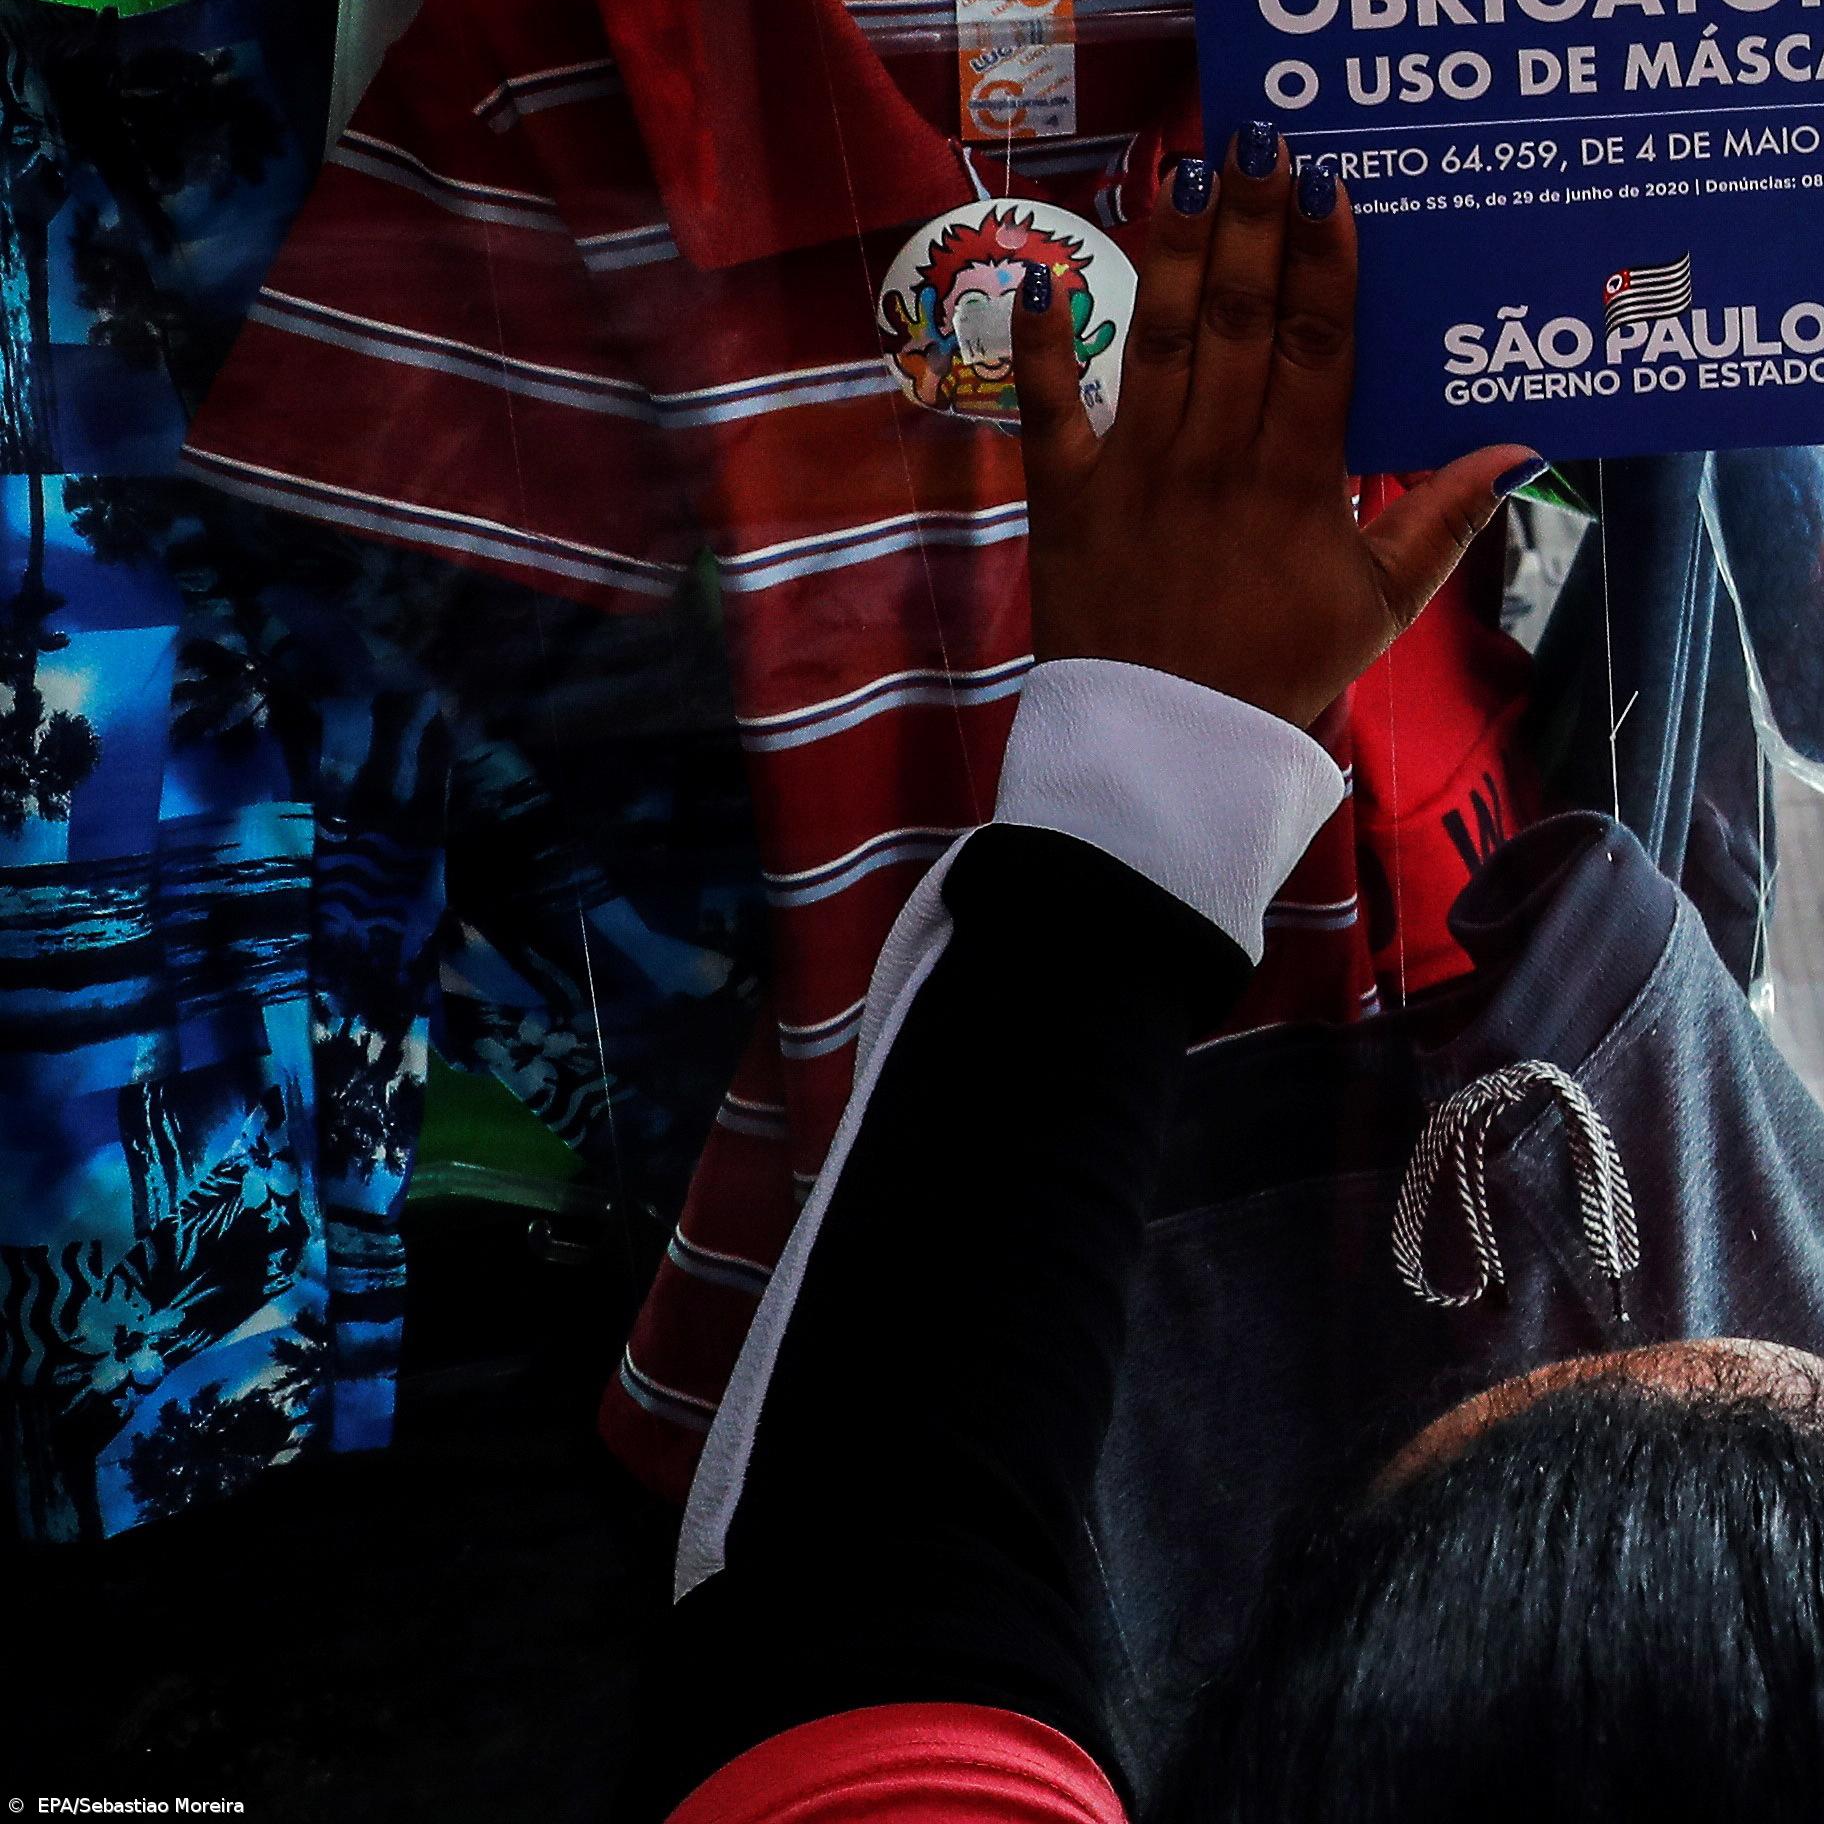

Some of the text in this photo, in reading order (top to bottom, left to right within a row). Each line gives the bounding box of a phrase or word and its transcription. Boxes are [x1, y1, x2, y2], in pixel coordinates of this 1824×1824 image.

[1264, 60, 1319, 110] O
[1346, 50, 1492, 106] USO
[1518, 45, 1598, 96] DE
[1290, 148, 1429, 179] ECRETO
[1441, 140, 1568, 174] 64.959,
[1581, 136, 1625, 166] DE
[1635, 133, 1657, 162] 4
[1668, 131, 1711, 161] DE
[1723, 125, 1820, 158] MAIO
[1350, 197, 1421, 216] solução
[1426, 195, 1448, 210] SS
[1453, 193, 1481, 210] 96,
[1485, 191, 1507, 207] de
[1512, 190, 1534, 205] 29
[1538, 187, 1561, 203] de
[1565, 185, 1613, 205] junho
[1618, 183, 1640, 199] de
[1645, 180, 1690, 197] 2020
[1705, 175, 1797, 194] Denúncias:
[1443, 304, 1594, 376] SÃO
[1444, 370, 1621, 407] GOVERNO
[1633, 365, 1688, 394] DO
